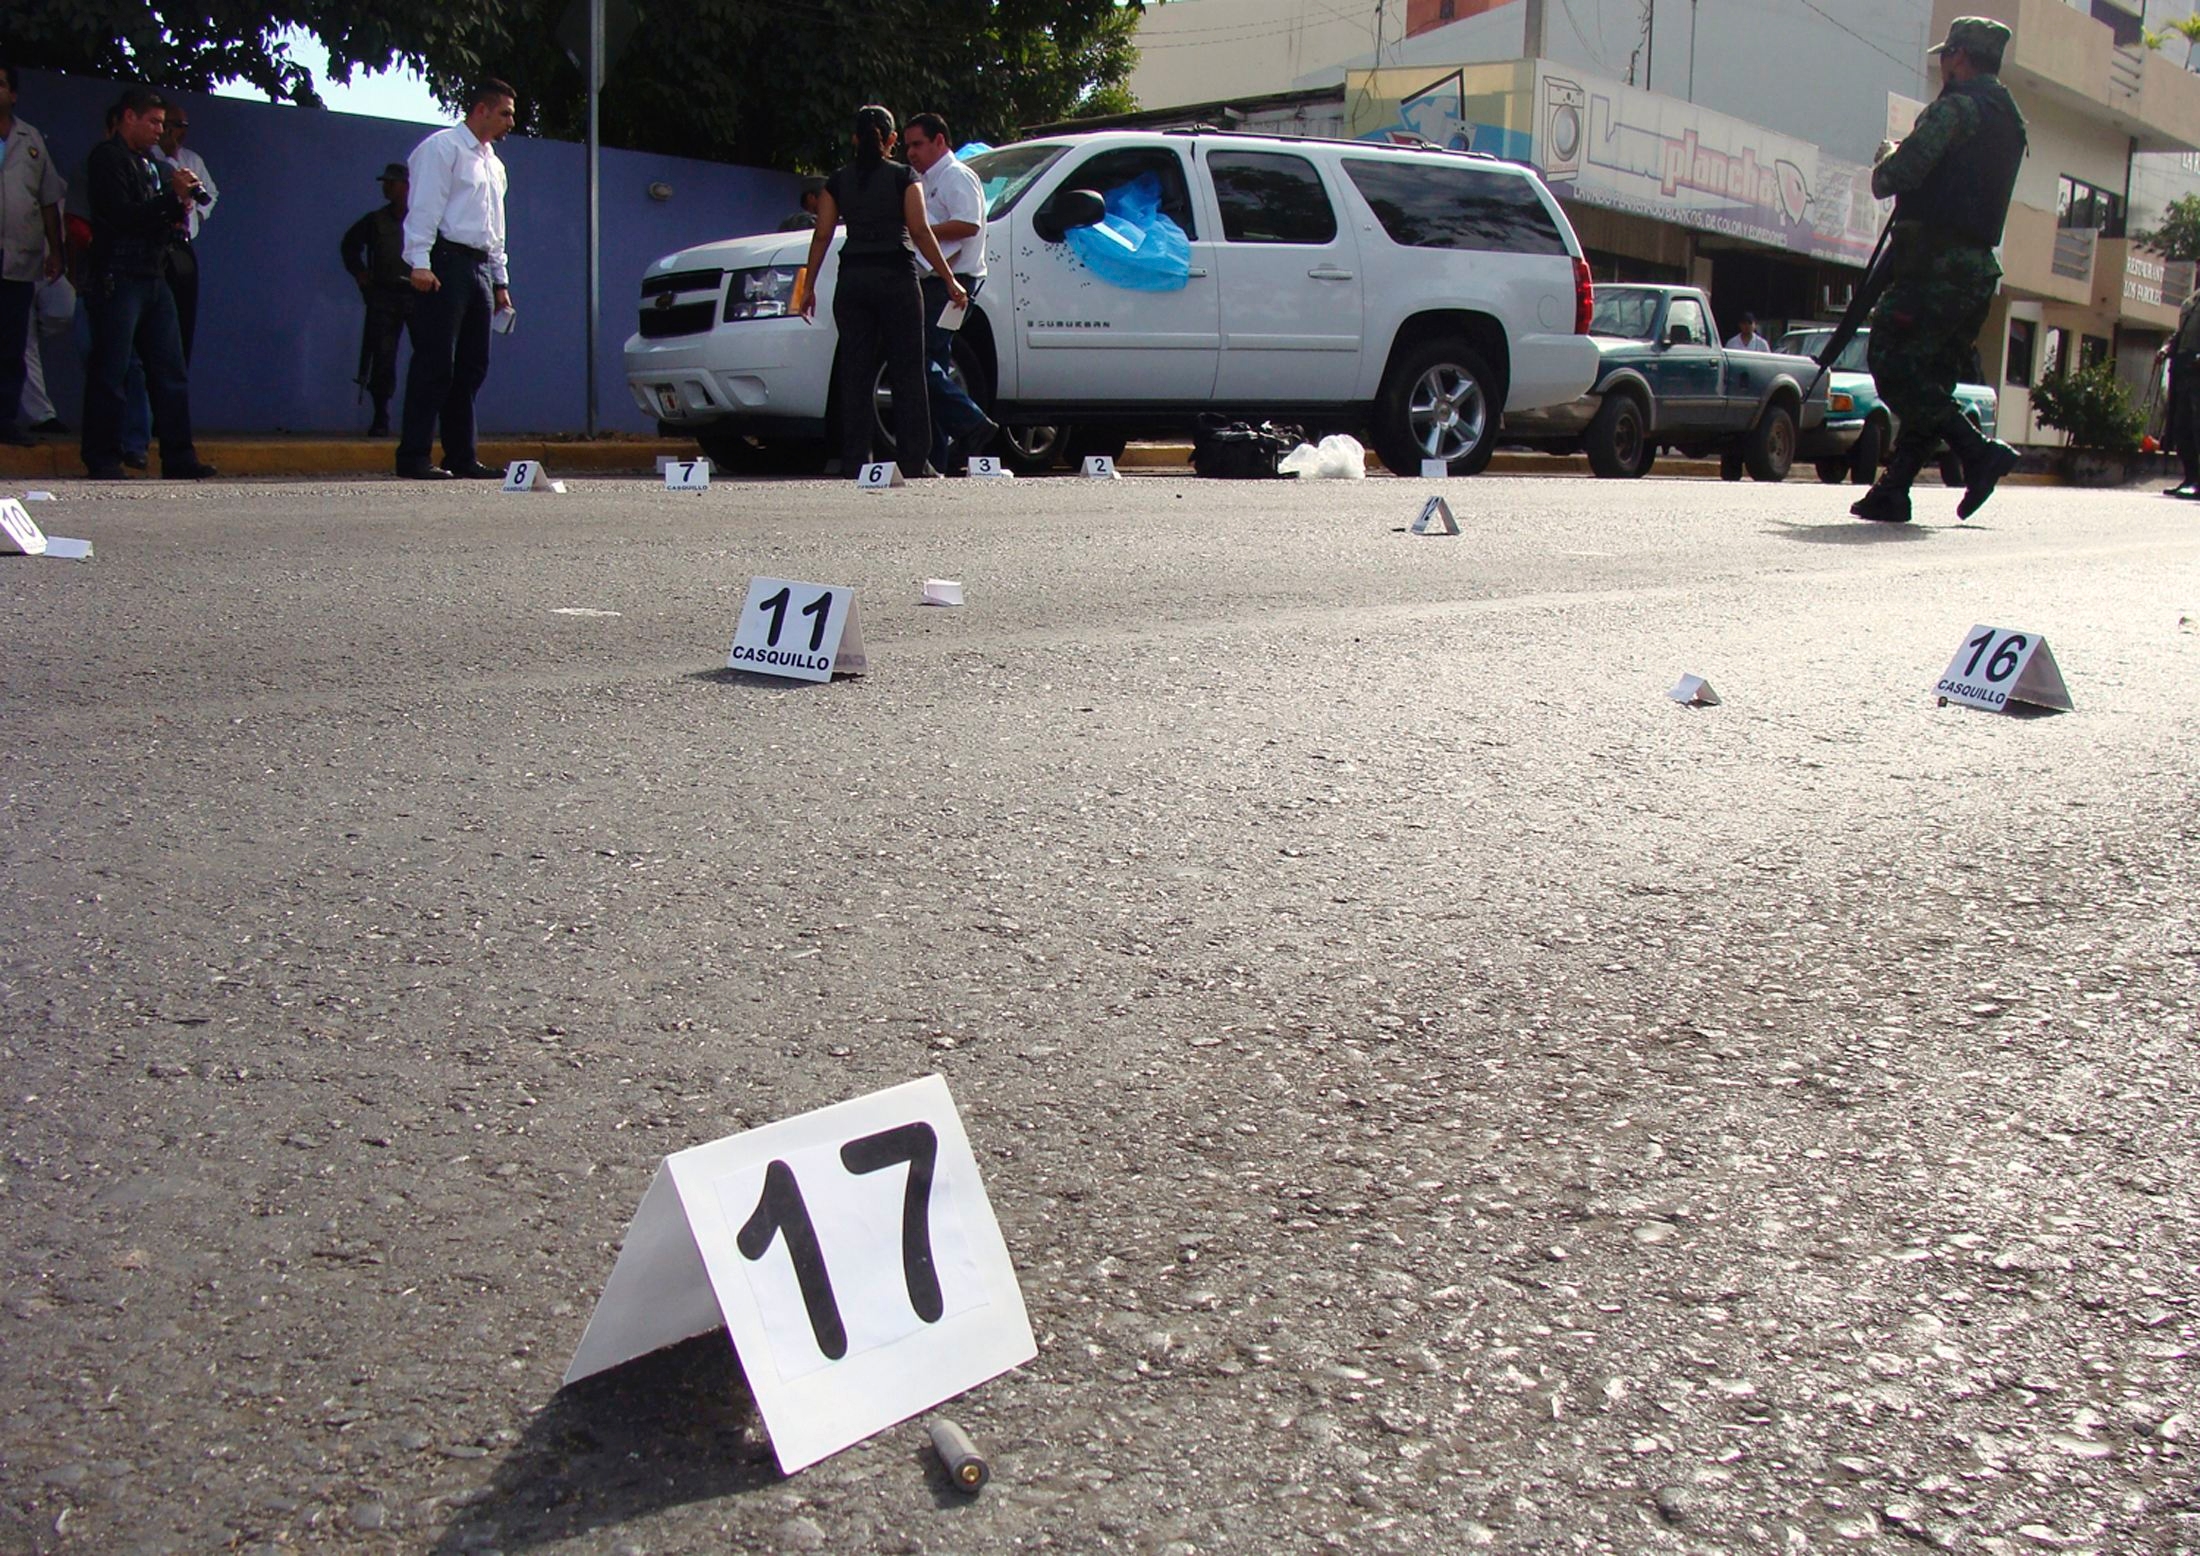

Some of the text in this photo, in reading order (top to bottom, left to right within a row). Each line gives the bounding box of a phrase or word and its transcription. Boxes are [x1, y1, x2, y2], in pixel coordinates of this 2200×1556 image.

[1717, 215, 1742, 236] COLOR
[1038, 320, 1110, 328] SUBURBAN
[513, 463, 527, 484] 8
[679, 463, 694, 483] 7
[869, 465, 883, 483] 6
[979, 458, 991, 472] 3
[1094, 458, 1106, 472] 2
[2, 505, 36, 540] 10
[759, 587, 832, 652] 11
[732, 645, 829, 671] CASQUILLO
[1969, 629, 2027, 683] 16
[1937, 679, 2006, 704] CASQUILLO
[736, 1121, 944, 1361] 17
